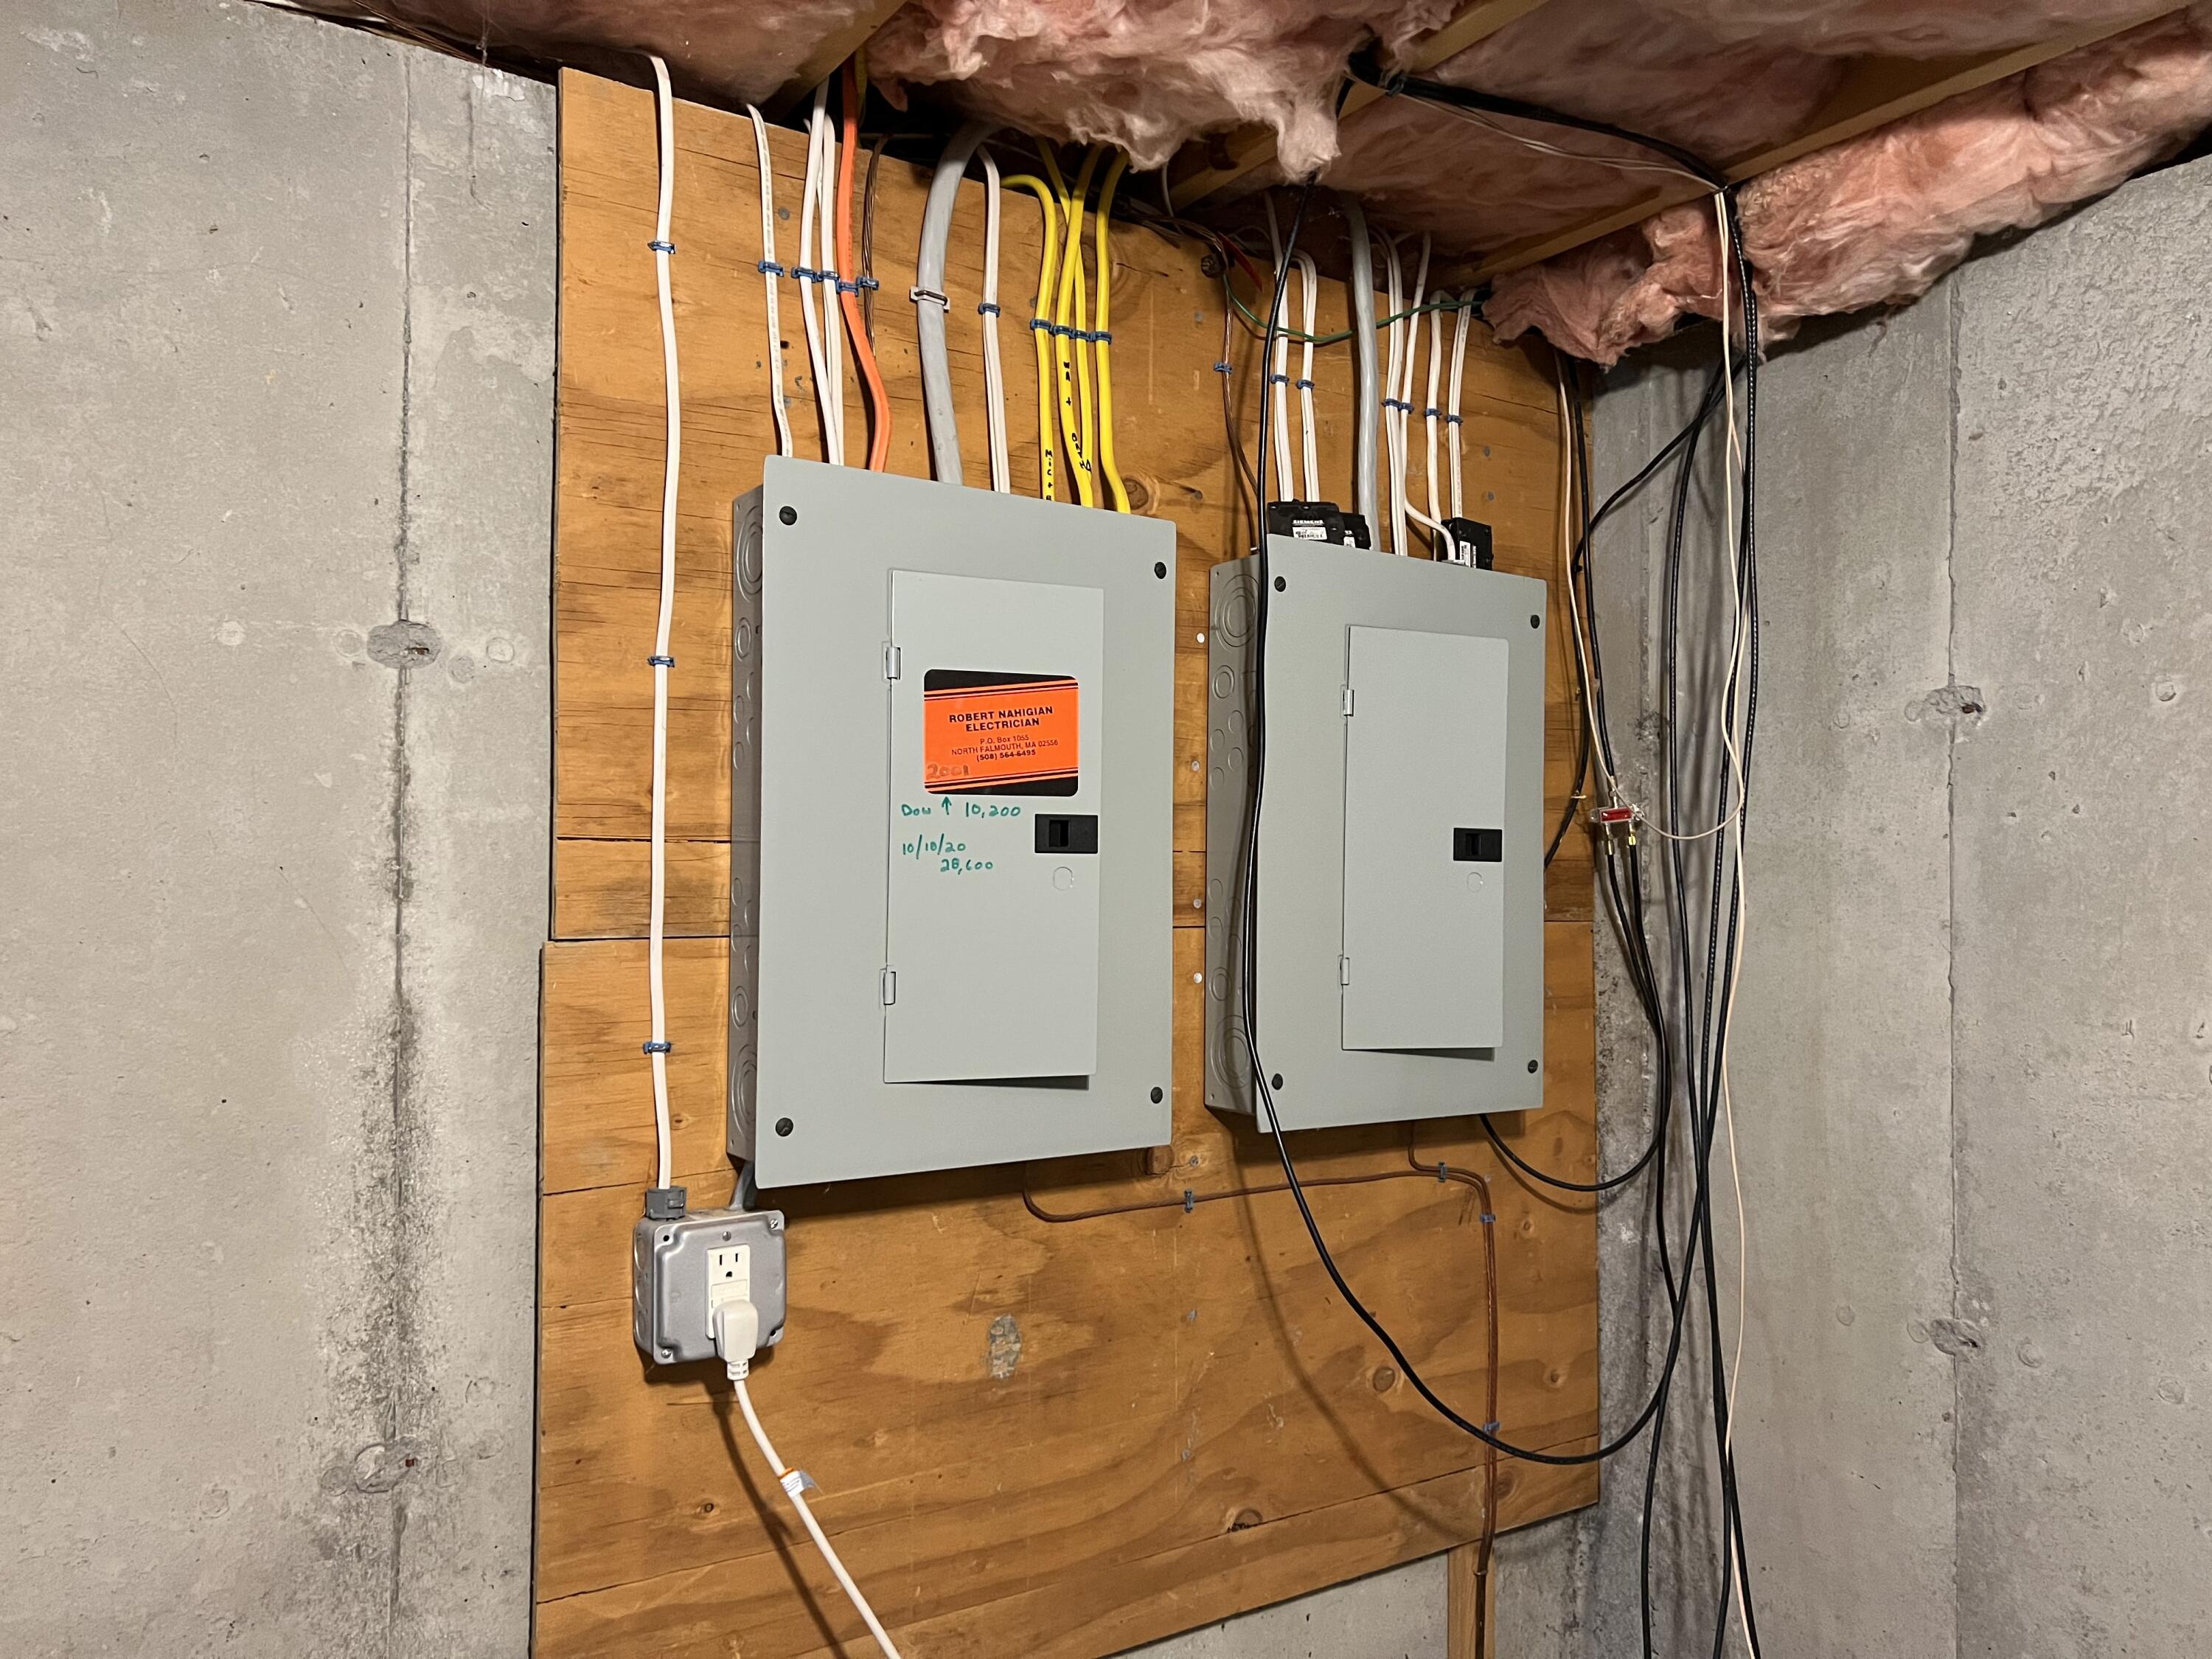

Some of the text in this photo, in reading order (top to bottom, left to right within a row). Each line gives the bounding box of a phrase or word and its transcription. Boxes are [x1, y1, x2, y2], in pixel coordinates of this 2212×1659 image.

[949, 706, 1053, 723] ROBERT NAHIGIAN
[966, 717, 1040, 731] ELECTRICIAN
[951, 746, 978, 755] NORTH
[980, 743, 1023, 753] FALMOUTH,
[976, 754, 998, 762] (508)
[926, 763, 970, 780] 2001
[965, 801, 1020, 818] 10,200
[940, 858, 993, 874] 28,600
